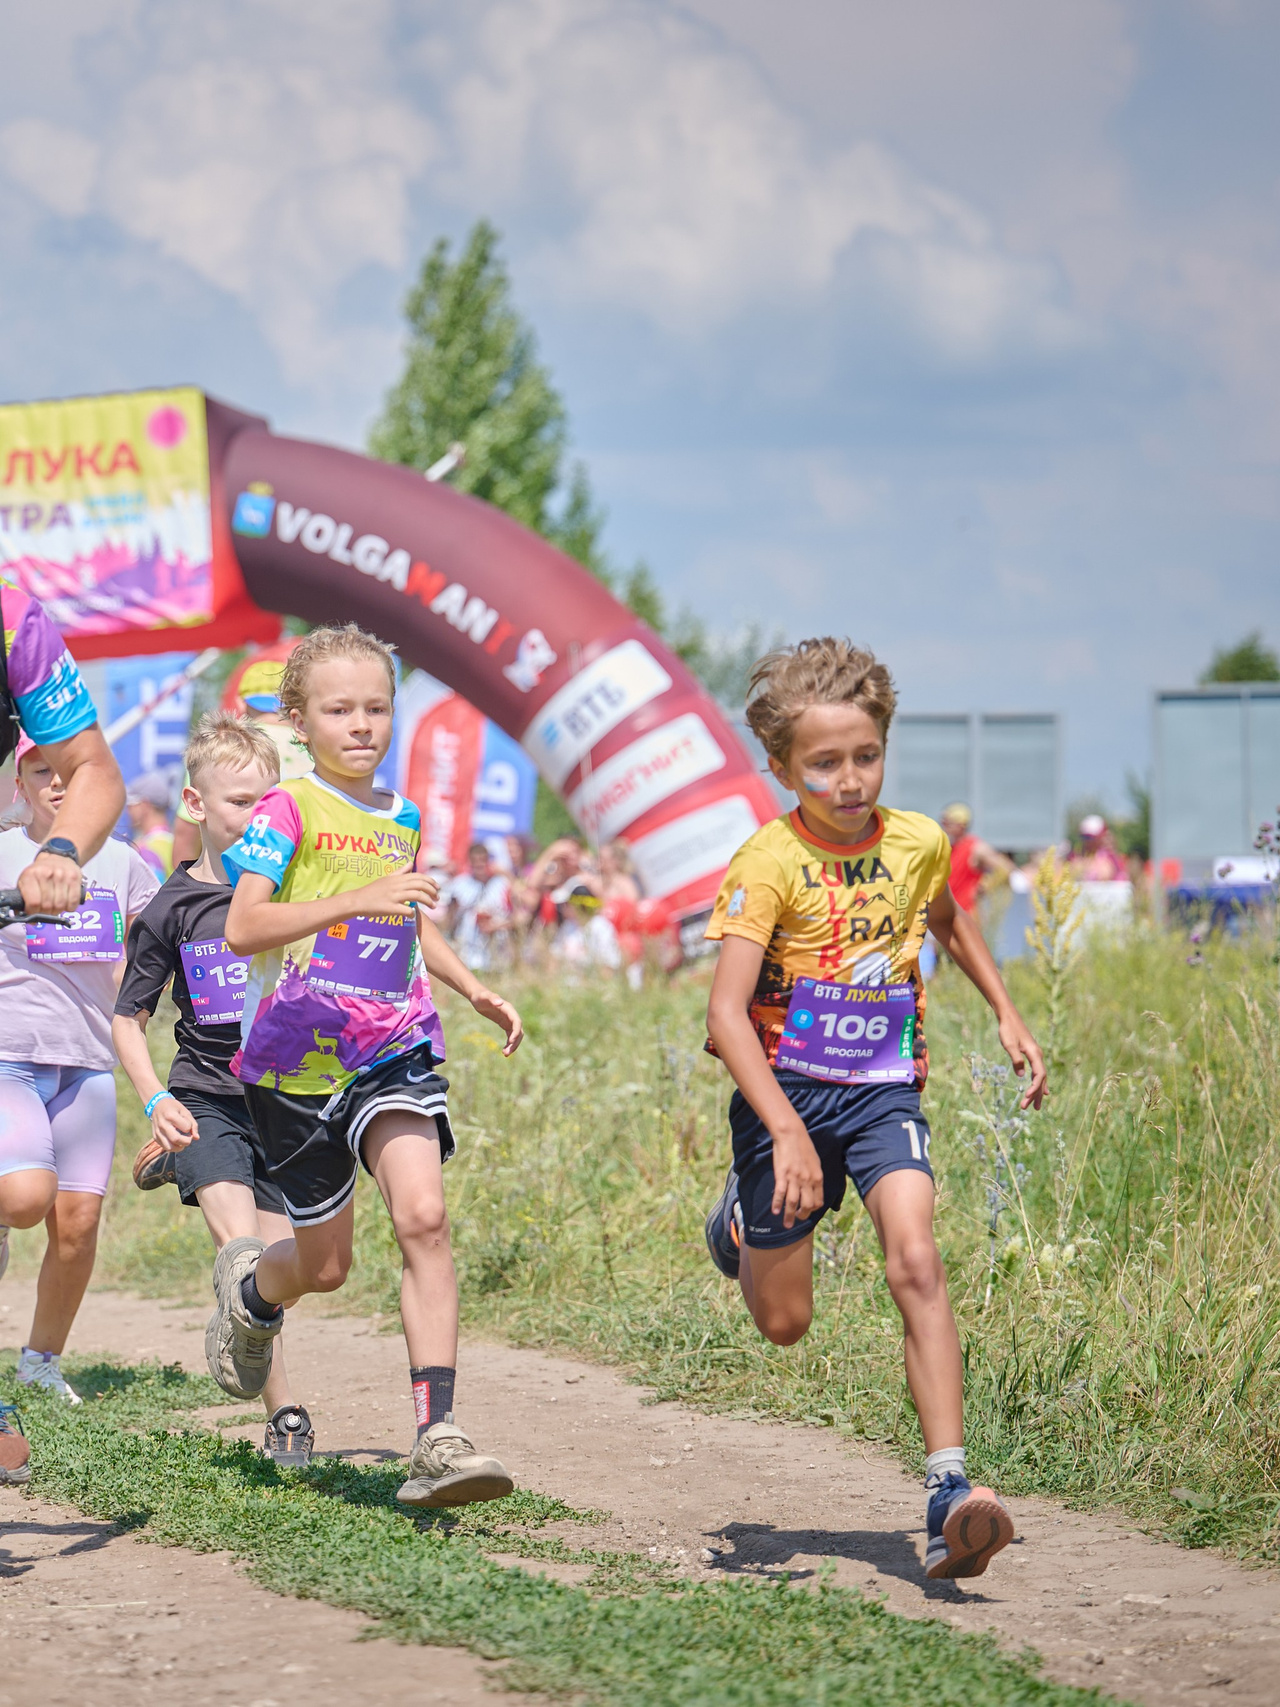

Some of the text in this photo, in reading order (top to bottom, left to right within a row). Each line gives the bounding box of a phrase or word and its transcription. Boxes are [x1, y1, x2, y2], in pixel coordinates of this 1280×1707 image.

[2, 441, 141, 486] ЛУКА
[314, 832, 380, 857] ЛУКА
[321, 854, 382, 878] ТРЕЙЛ
[801, 857, 894, 888] LUKA
[58, 935, 98, 944] ЕВДОКИЯ
[194, 943, 217, 957] ВТБ
[357, 934, 399, 962] 77
[814, 984, 910, 1003] ВТБ ЛУКА УЛЬТРА
[819, 1013, 889, 1041] 106
[901, 1018, 913, 1057] ТРЕЙЛ
[823, 1046, 874, 1057] ЯРОСЛАВ
